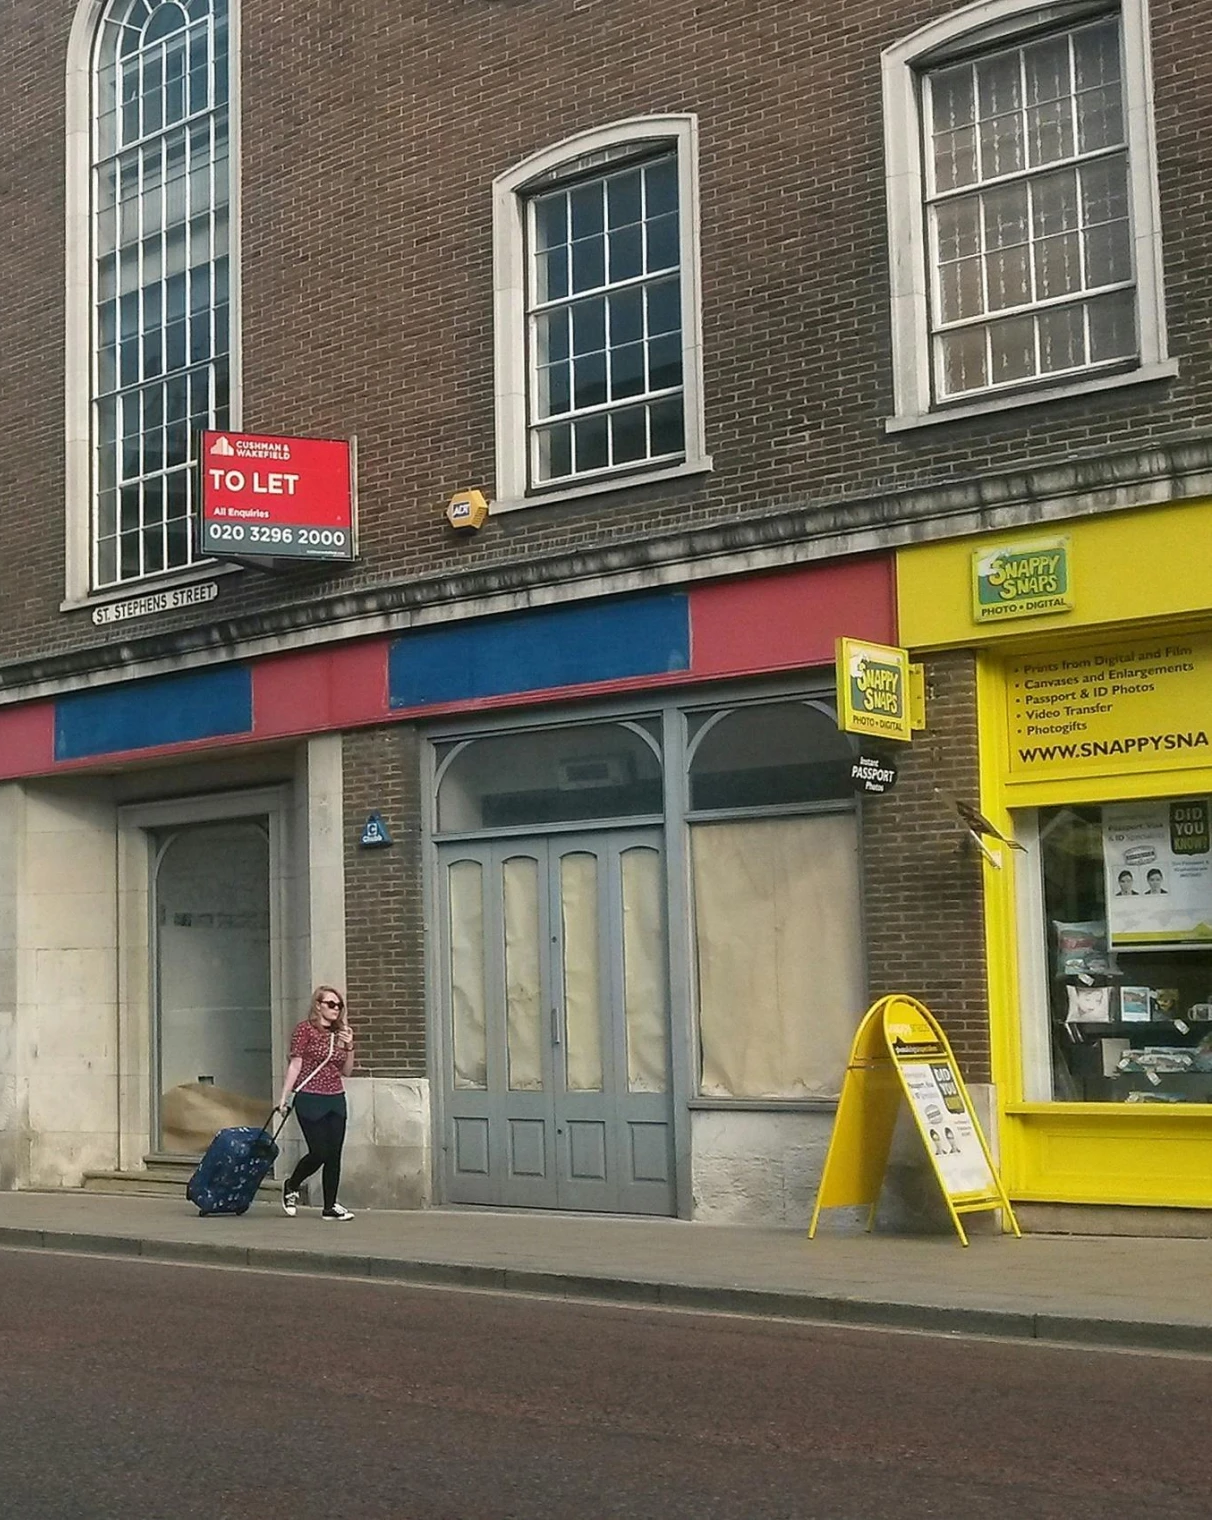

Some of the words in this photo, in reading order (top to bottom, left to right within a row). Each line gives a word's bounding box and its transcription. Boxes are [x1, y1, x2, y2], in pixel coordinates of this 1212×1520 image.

[236, 440, 282, 452] CUSHMAN
[283, 444, 290, 452] &
[236, 450, 290, 460] WAKEFIELD
[209, 469, 245, 492] TO
[253, 472, 299, 495] LET
[214, 507, 226, 516] All
[228, 508, 269, 519] Enquiries
[209, 524, 245, 540] 020
[250, 527, 293, 543] 3296
[298, 530, 345, 546] 2000
[989, 555, 1060, 585] SNAPPY
[999, 575, 1058, 599] SNAPS
[96, 608, 110, 623] ST.
[115, 594, 167, 619] STEPHENS
[172, 584, 214, 606] STREET
[982, 604, 1017, 616] PHOTO
[1026, 598, 1067, 610] DIGITAL
[1024, 663, 1058, 674] Prints
[1062, 659, 1091, 670] from
[1095, 651, 1135, 667] Digital
[1138, 649, 1161, 660] and
[1165, 646, 1193, 657] Film
[857, 663, 898, 693] SNAPPY
[1024, 676, 1079, 690] Canvases
[1082, 671, 1105, 683] and
[1108, 661, 1194, 680] Enlargements
[864, 688, 898, 714] SNAPS
[1025, 690, 1076, 709] Passport
[1080, 688, 1089, 699] &
[1093, 686, 1108, 698] ID
[1112, 682, 1155, 695] Photos
[1025, 709, 1061, 720] Video
[1064, 702, 1113, 717] Transfer
[853, 715, 875, 727] PHOTO
[879, 719, 903, 731] DIGITAL
[1026, 720, 1088, 736] Photogifts
[1018, 731, 1209, 763] WWW.SNAPPYSNA
[860, 756, 879, 768] Instant
[851, 765, 895, 782] PASSPORT
[865, 781, 884, 792] Photos
[1176, 822, 1204, 835] YOU
[934, 1068, 951, 1082] DID
